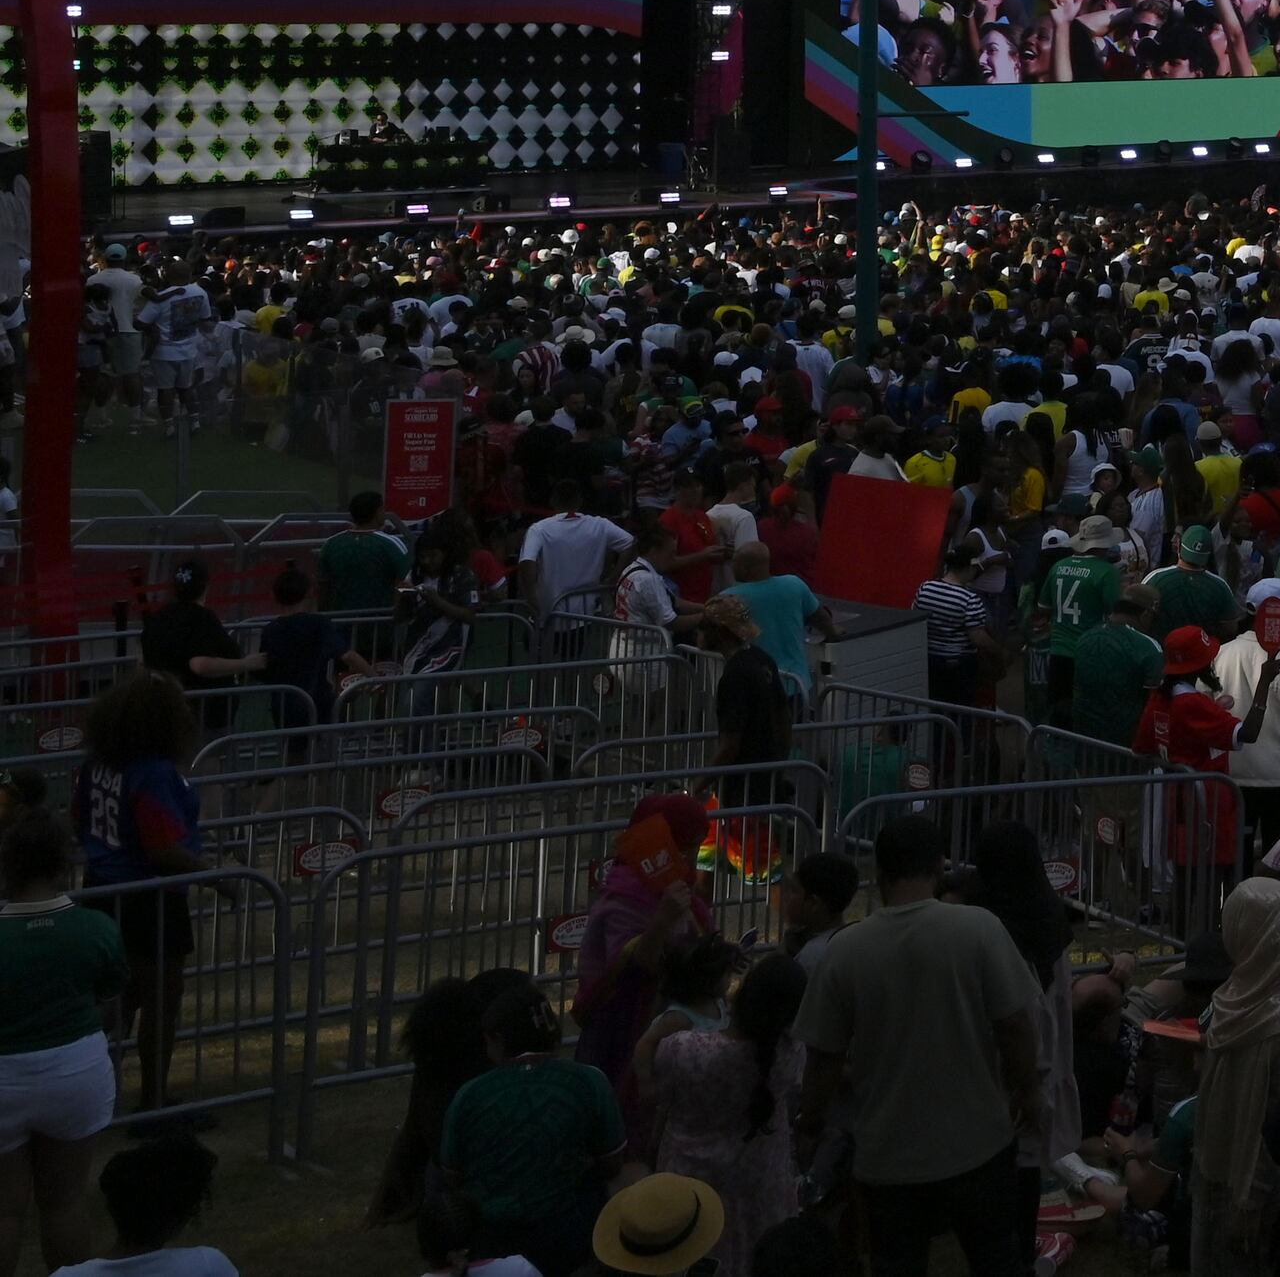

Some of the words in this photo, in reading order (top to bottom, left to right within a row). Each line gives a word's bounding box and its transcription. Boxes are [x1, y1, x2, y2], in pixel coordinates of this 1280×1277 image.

[1056, 566, 1091, 579] CHICHARITO
[1056, 578, 1082, 625] 14
[91, 763, 123, 797] USA
[90, 788, 121, 847] 26
